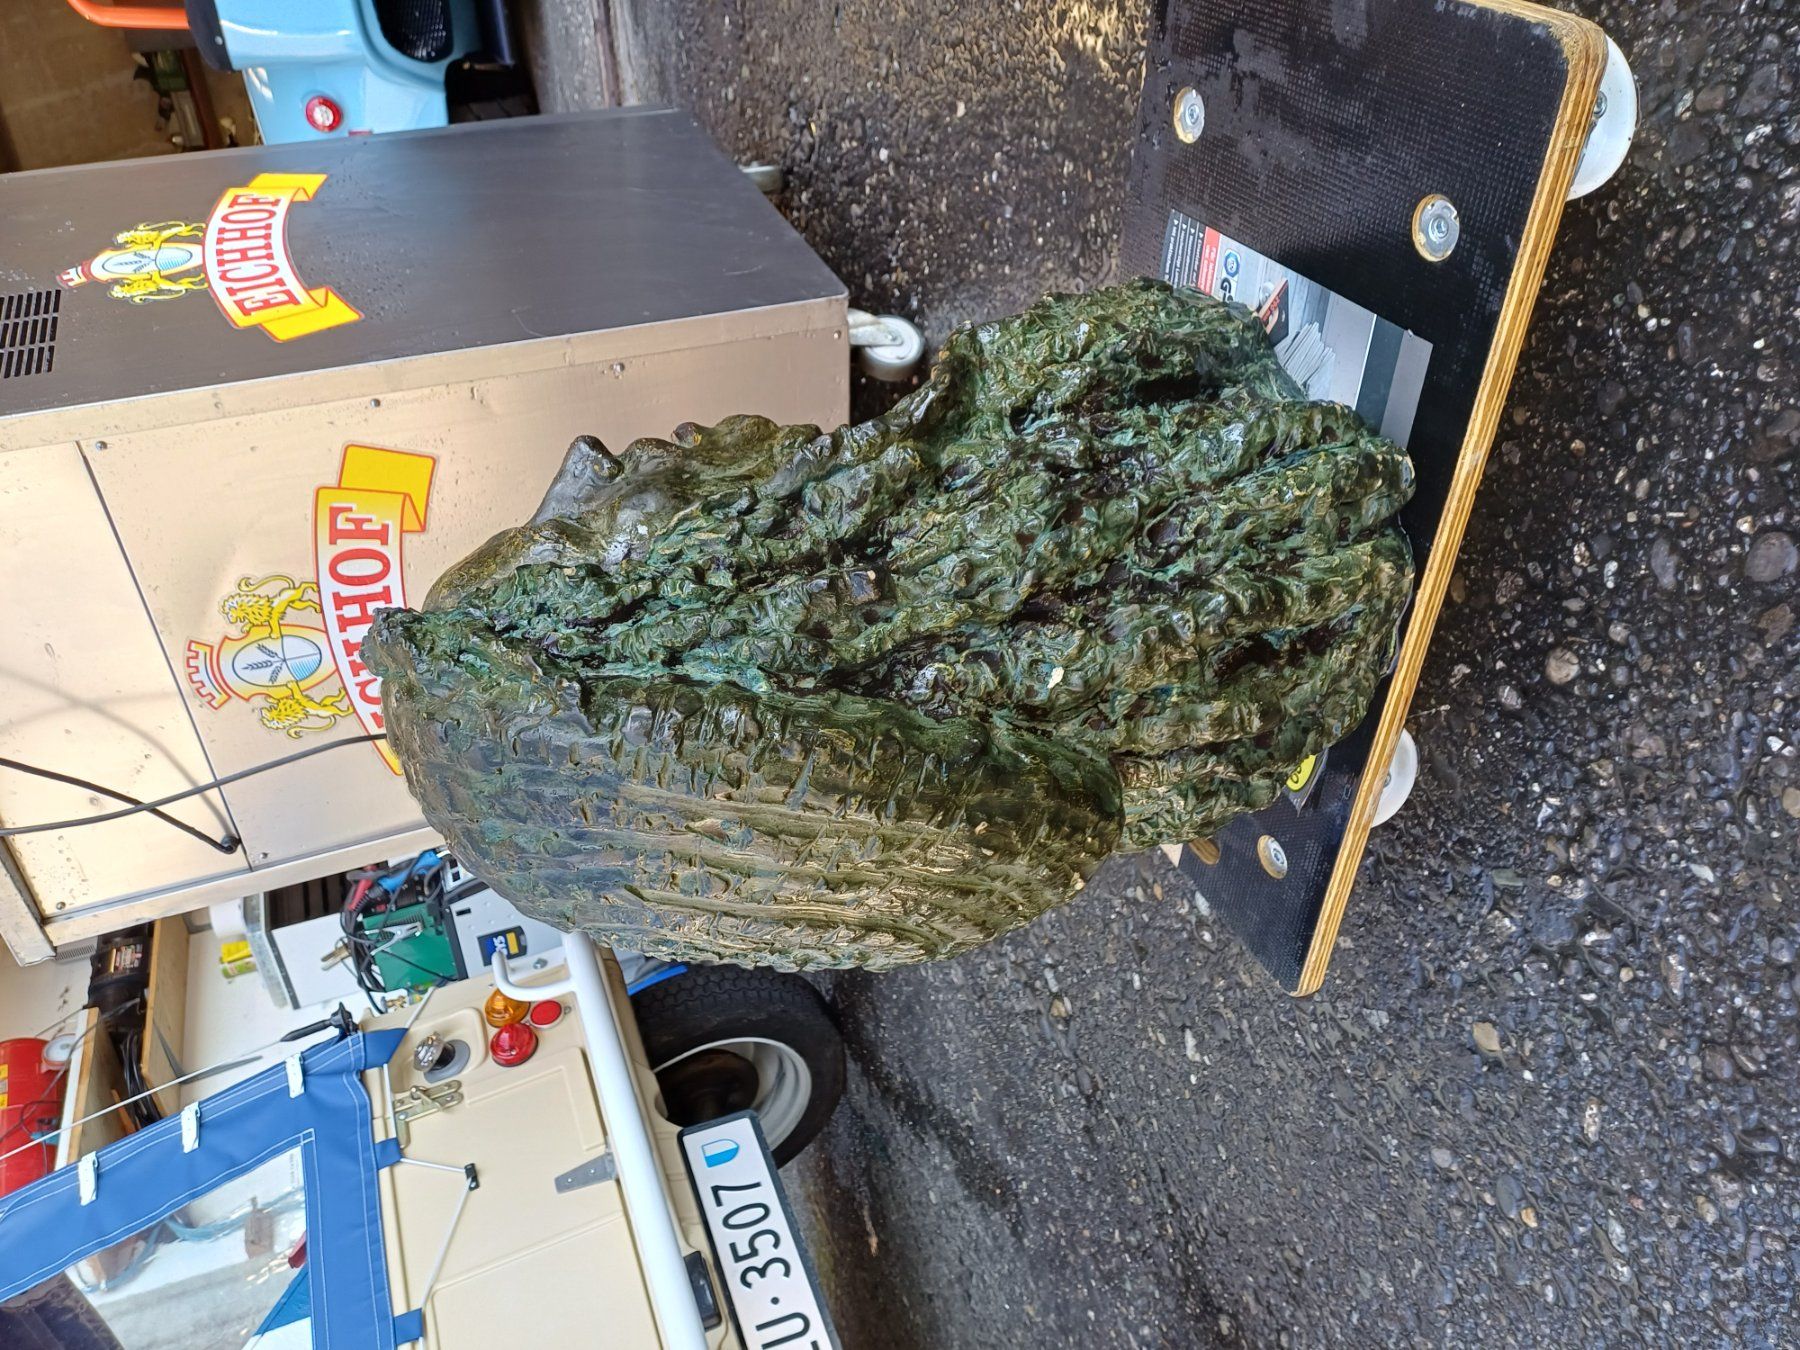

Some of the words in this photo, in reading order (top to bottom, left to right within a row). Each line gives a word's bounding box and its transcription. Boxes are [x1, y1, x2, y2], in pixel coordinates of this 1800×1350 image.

[216, 194, 302, 316] EICHHOF
[711, 1182, 791, 1289] 3507
[755, 1312, 823, 1350] U
